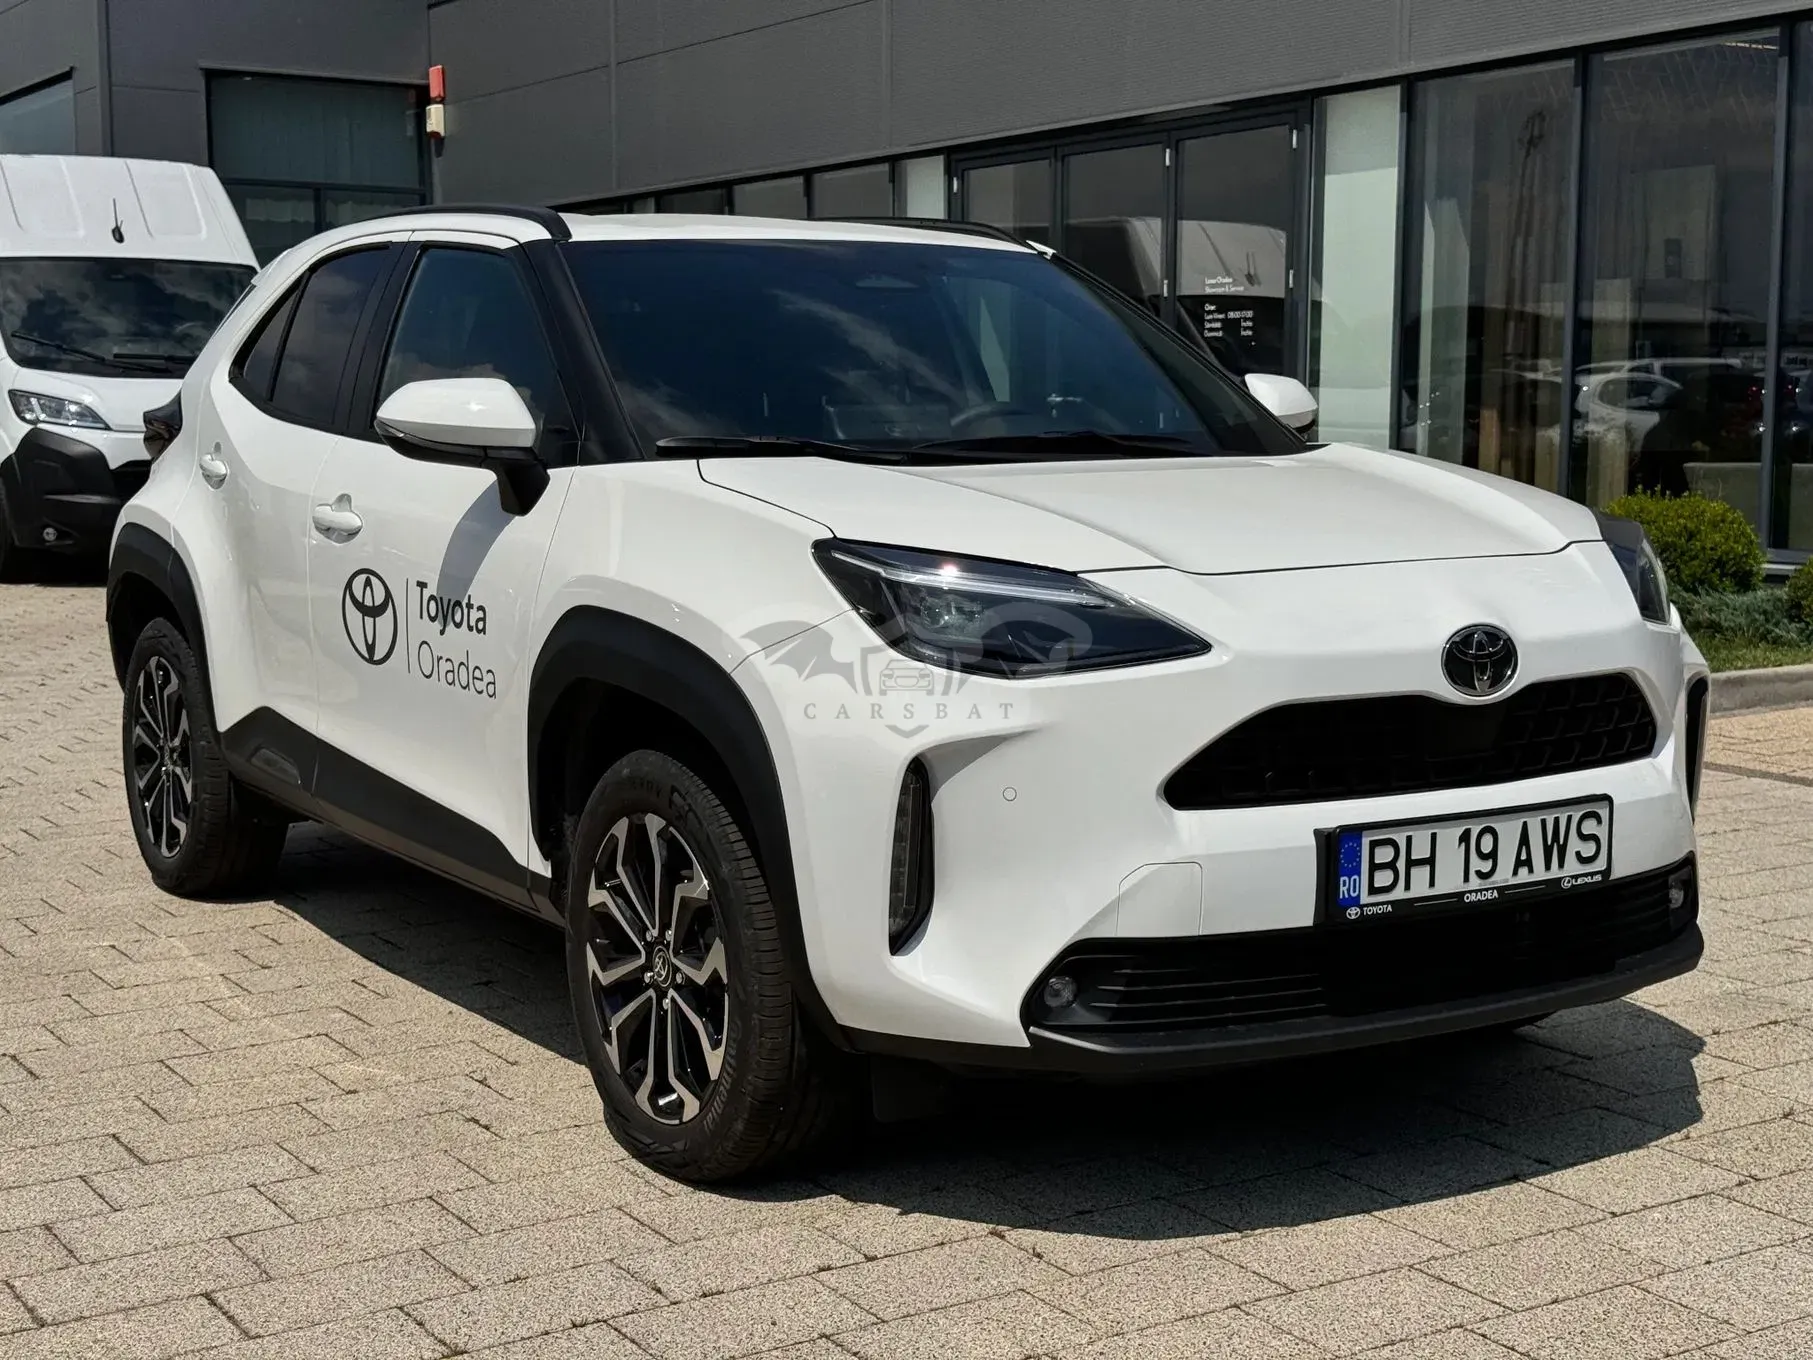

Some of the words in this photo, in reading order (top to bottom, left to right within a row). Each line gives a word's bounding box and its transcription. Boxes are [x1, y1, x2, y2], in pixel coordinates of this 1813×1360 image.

[416, 580, 487, 636] Toyota
[417, 640, 497, 700] Oradea
[1367, 831, 1438, 897] BH
[1457, 824, 1500, 884] 19
[1511, 809, 1603, 878] AWS
[1339, 874, 1360, 899] RO
[1572, 874, 1602, 886] LEXUS
[1463, 888, 1499, 903] ORADEA
[1362, 904, 1393, 916] TOYOTA
